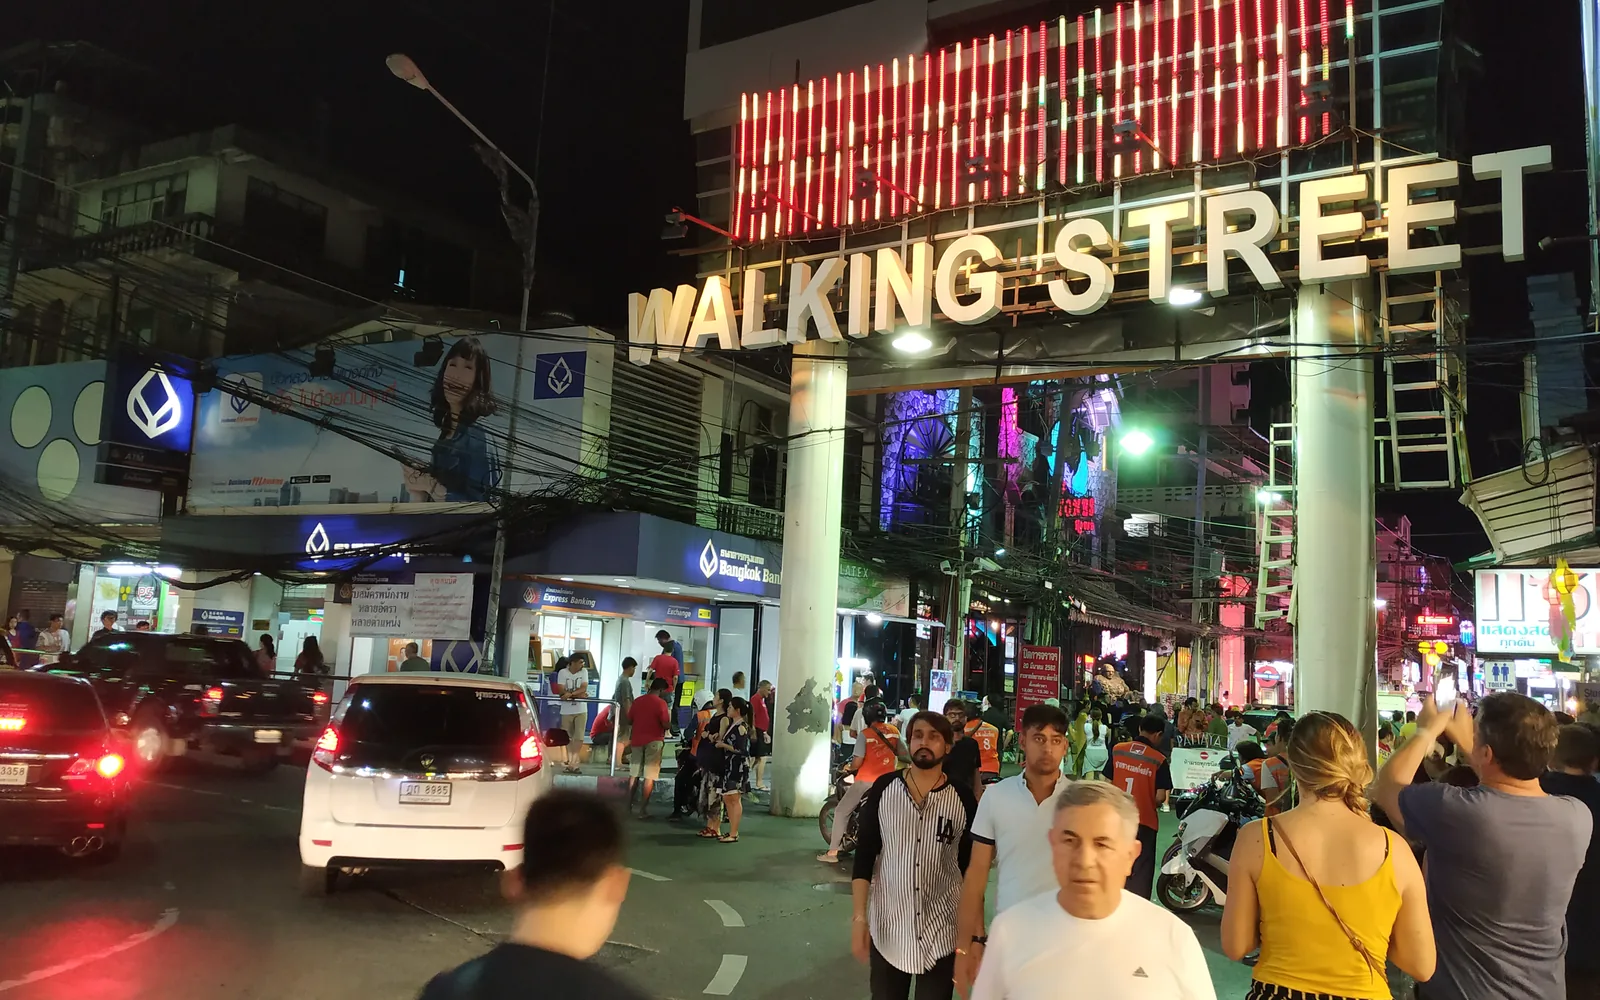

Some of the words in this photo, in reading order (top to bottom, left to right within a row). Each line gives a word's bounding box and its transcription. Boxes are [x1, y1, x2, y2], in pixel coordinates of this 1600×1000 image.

[628, 235, 1006, 365] WALKING
[1047, 144, 1553, 316] STREET
[719, 559, 762, 583] Bangkok
[840, 563, 869, 579] LATEX
[358, 601, 397, 614] หลายอัตรา
[543, 593, 569, 604] Express
[570, 596, 596, 608] Banking
[667, 607, 692, 619] Exchange
[352, 616, 401, 629] หลายตำแหน่ง
[983, 737, 991, 751] 8
[0, 766, 25, 776] 3358
[1124, 777, 1134, 797] 1
